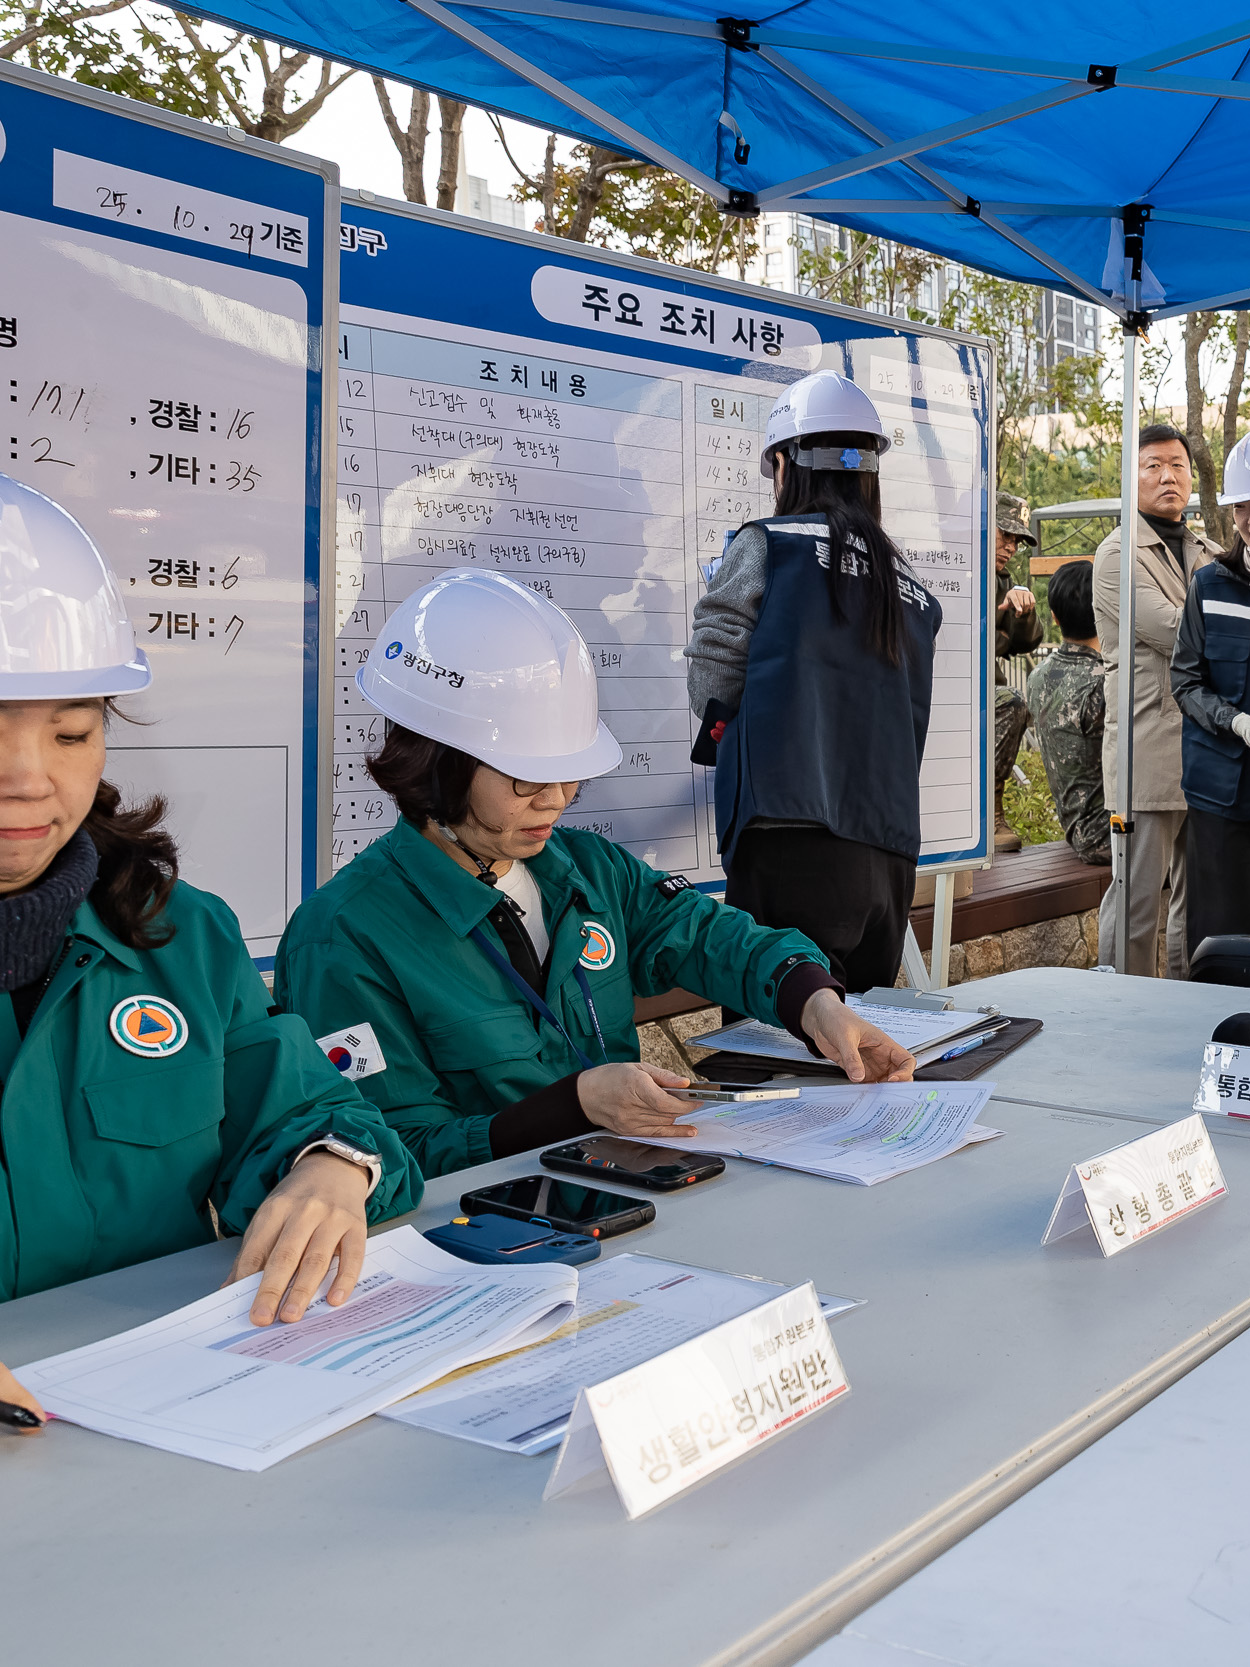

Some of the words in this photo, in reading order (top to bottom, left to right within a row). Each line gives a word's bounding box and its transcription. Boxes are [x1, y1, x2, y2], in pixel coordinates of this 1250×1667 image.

[229, 222, 254, 259] 29
[260, 221, 304, 254] 기준
[581, 283, 643, 327] 주요
[659, 304, 716, 344] 조치
[731, 317, 785, 357] 사항
[347, 379, 367, 398] 12
[409, 386, 468, 413] 신고접수
[480, 397, 496, 420] 및
[517, 404, 561, 430] 화재출동
[227, 408, 255, 440] 16
[339, 415, 354, 437] 15
[30, 437, 75, 466] 2
[344, 456, 360, 473] 16
[513, 437, 560, 468] 현장도착
[226, 461, 262, 491] 35
[411, 464, 455, 481] 지휘대
[468, 467, 518, 495] 현장도착
[346, 494, 361, 515] 17
[350, 531, 363, 551] 17
[221, 556, 240, 590] 6
[350, 574, 366, 591] 21
[225, 615, 244, 655] 7
[353, 610, 369, 632] 27
[403, 650, 465, 689] 광진구청
[358, 717, 377, 742] 36
[630, 752, 651, 773] 시작
[364, 800, 384, 820] 43
